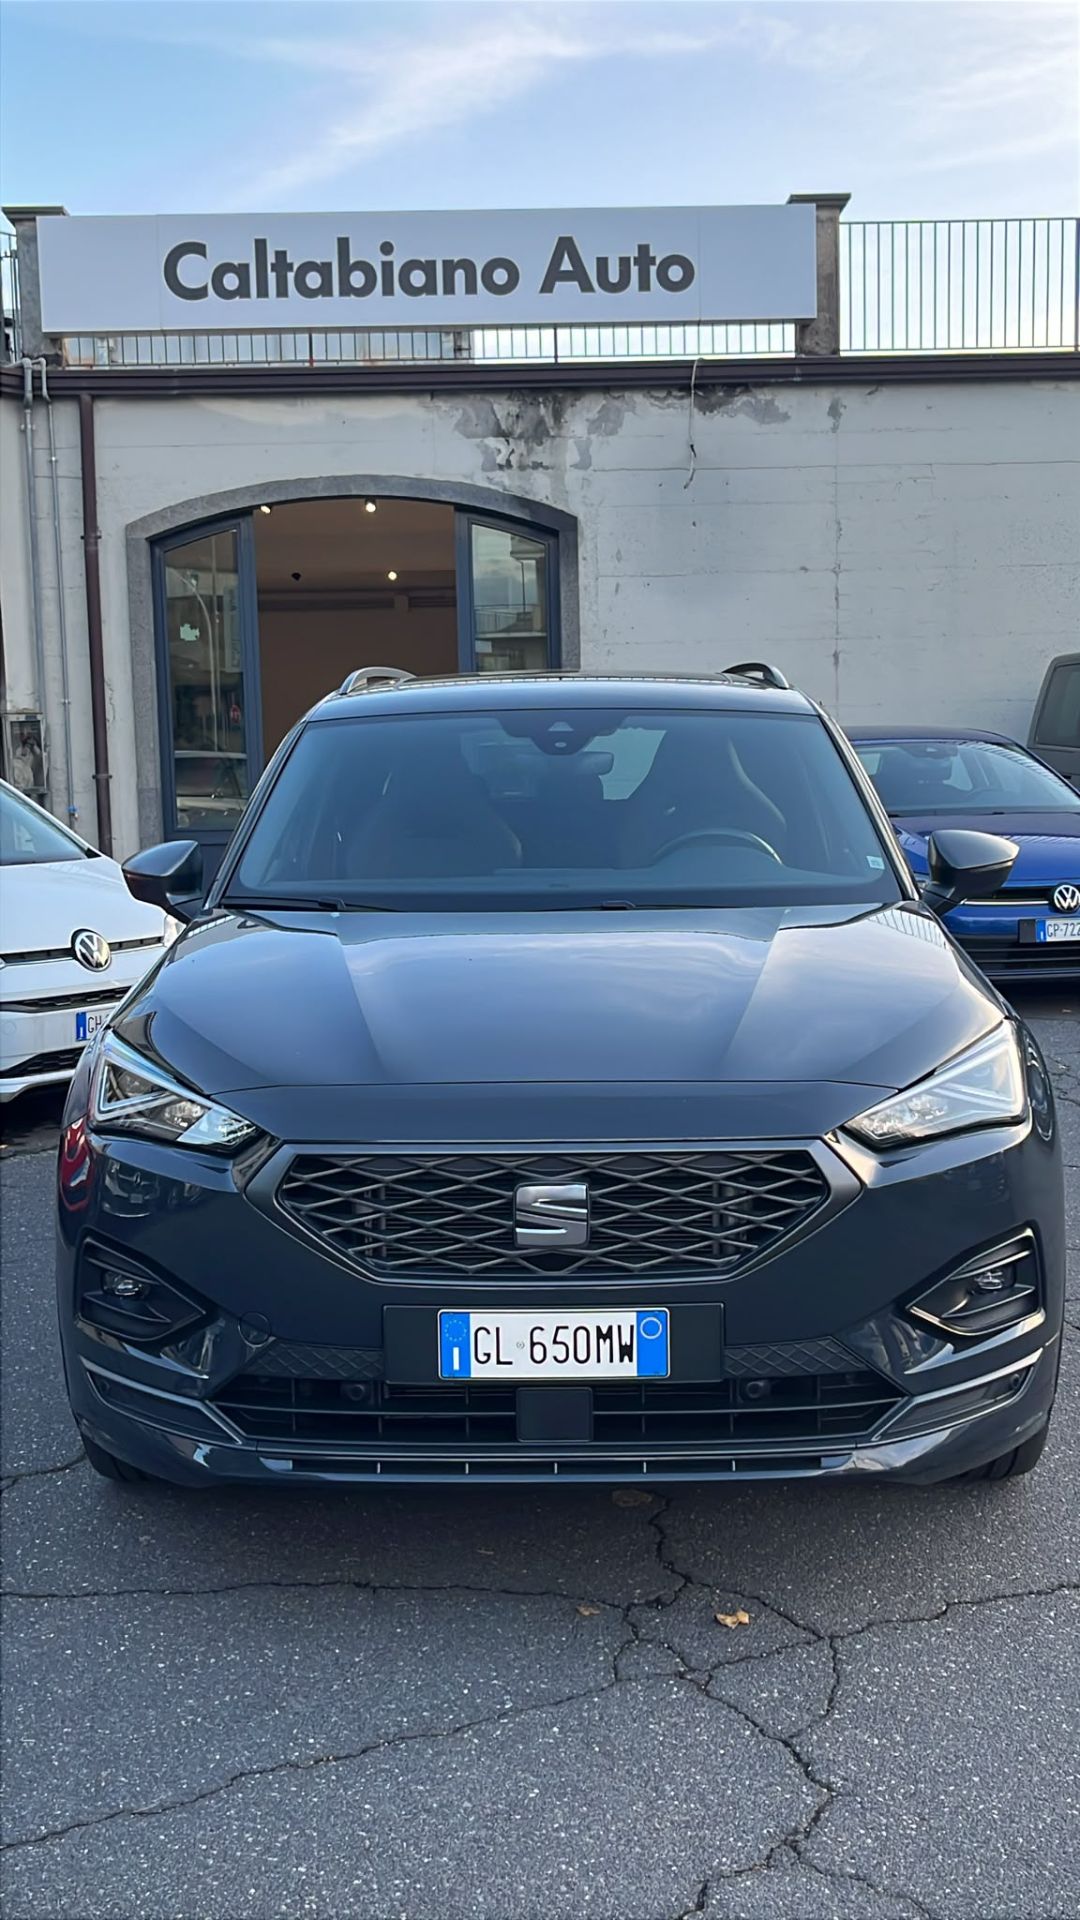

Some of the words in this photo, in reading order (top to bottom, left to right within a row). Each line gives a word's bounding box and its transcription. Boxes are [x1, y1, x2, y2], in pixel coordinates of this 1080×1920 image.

[163, 236, 520, 302] Caltabiano
[538, 235, 696, 294] Auto
[88, 1015, 102, 1033] GH
[473, 1326, 513, 1366] GL
[529, 1324, 635, 1365] 650MW
